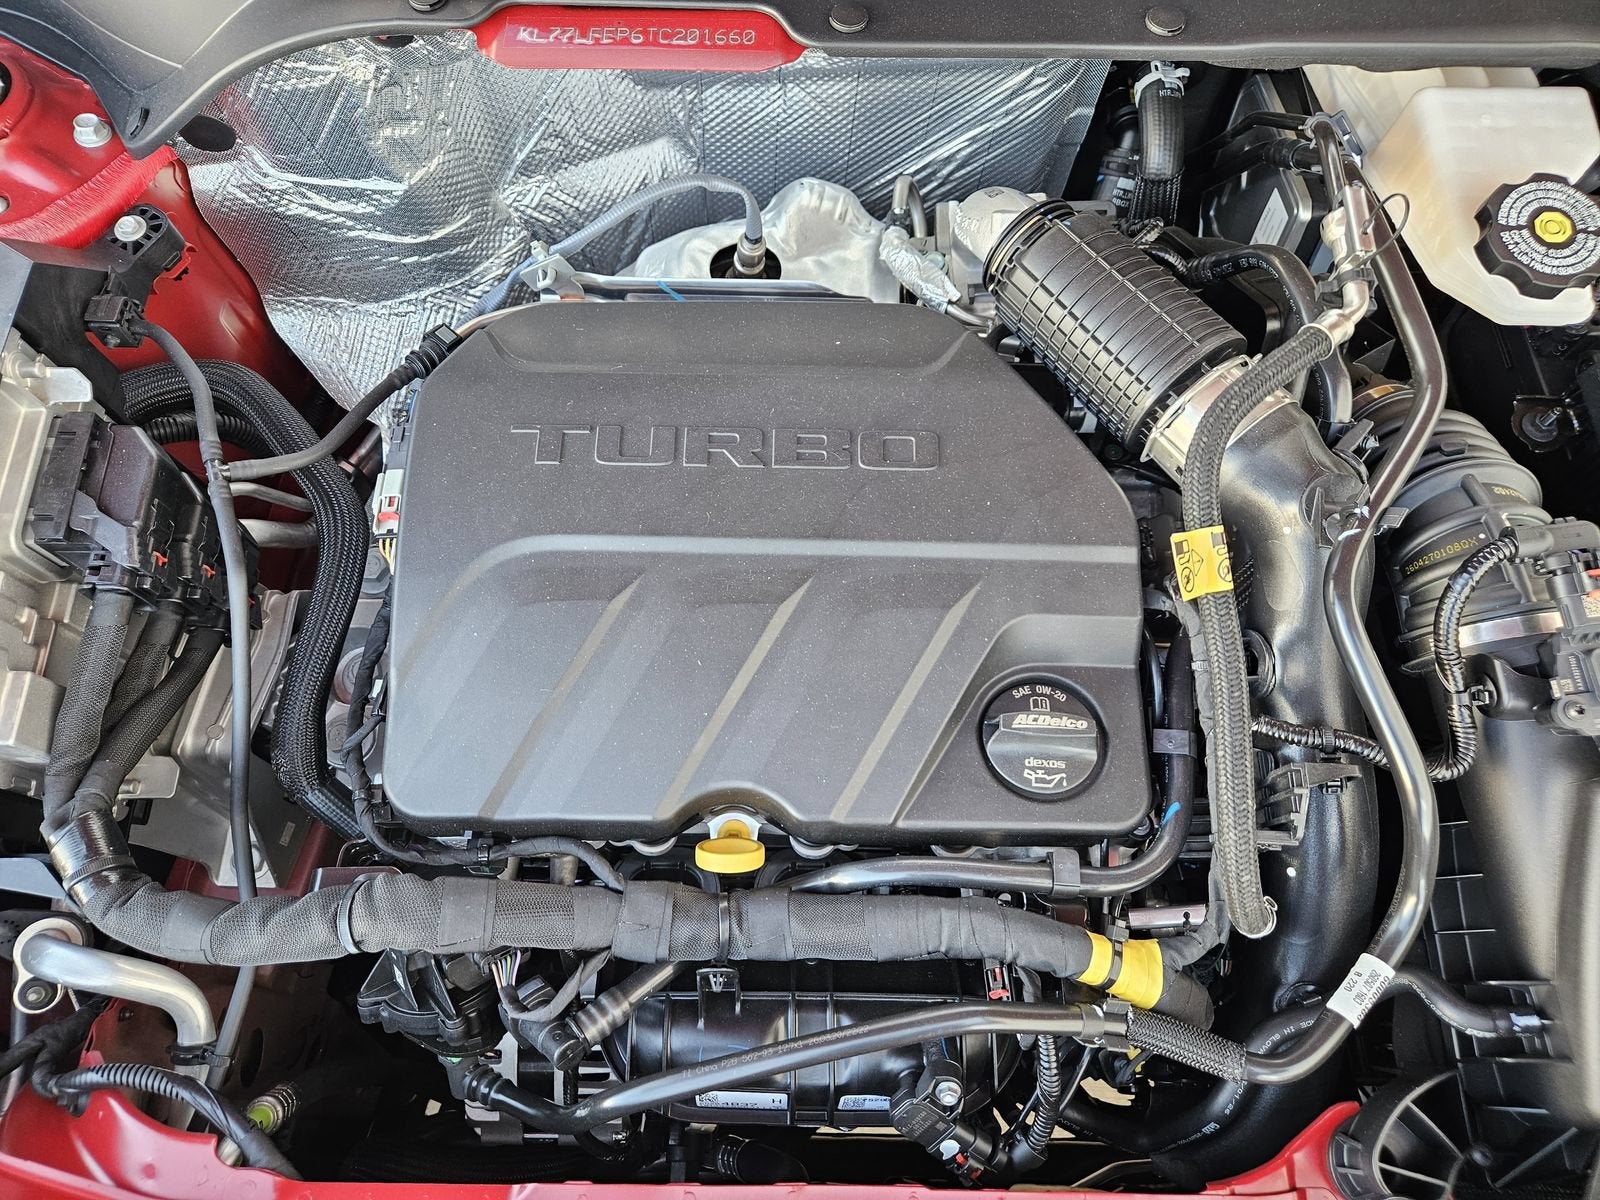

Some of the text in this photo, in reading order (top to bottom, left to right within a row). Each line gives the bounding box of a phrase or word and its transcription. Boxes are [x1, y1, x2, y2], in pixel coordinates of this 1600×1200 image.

[517, 26, 756, 45] KL77LFEP6TC201660
[511, 424, 940, 471] TURBO
[1012, 685, 1067, 702] SAE 0W-20
[1011, 714, 1088, 729] ACDelco
[1024, 757, 1067, 769] dexos
